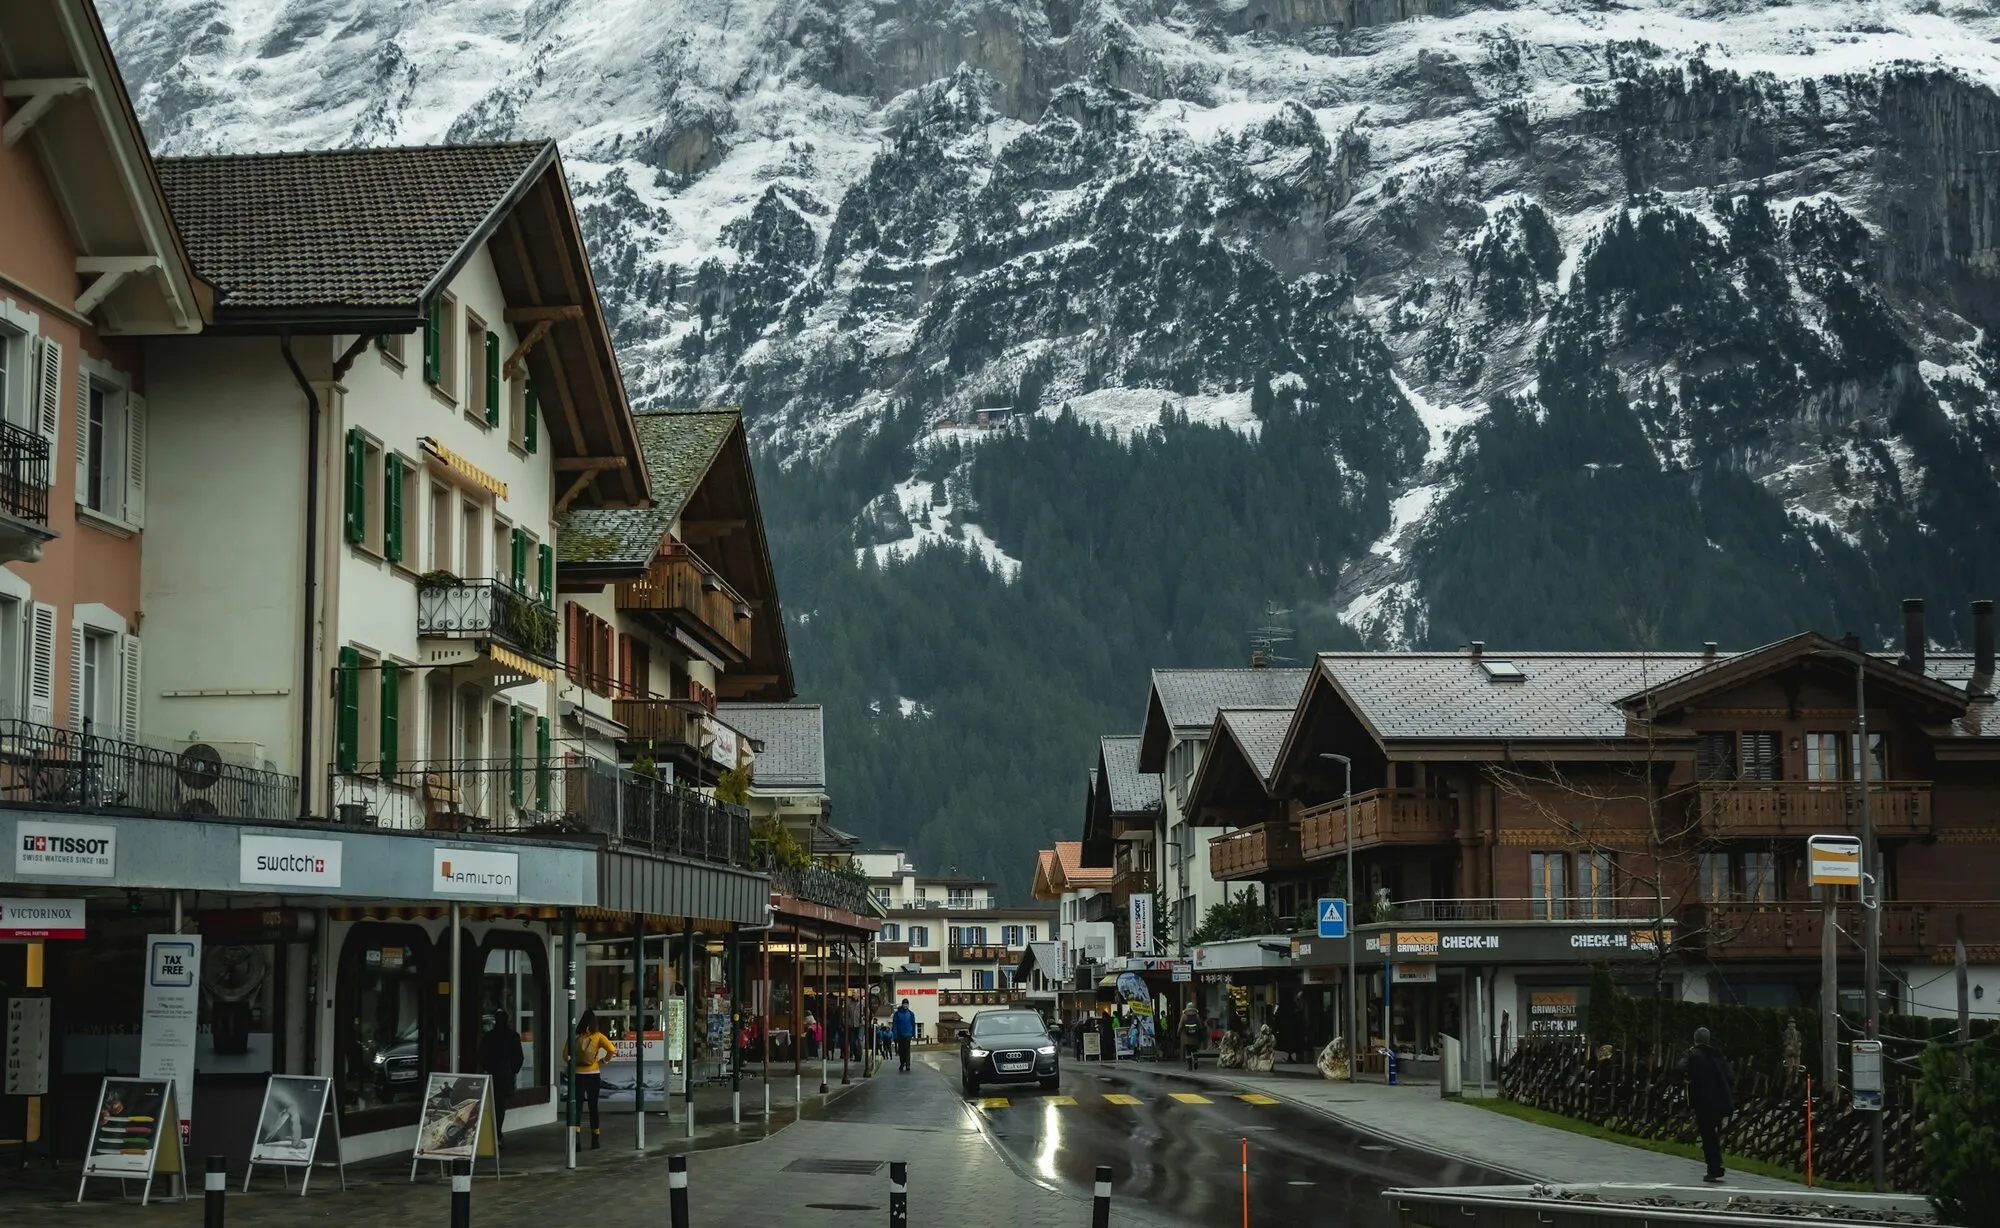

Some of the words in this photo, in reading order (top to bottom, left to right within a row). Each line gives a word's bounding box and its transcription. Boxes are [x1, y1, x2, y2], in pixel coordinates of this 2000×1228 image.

[48, 836, 108, 854] TISSOT
[22, 854, 43, 862] SWISS
[44, 855, 74, 863] WATCHES
[256, 854, 314, 873] swatch
[446, 872, 512, 886] HAMILTON
[10, 908, 72, 919] VICTORINOX
[1134, 899, 1142, 941] INTERSPORT
[1441, 936, 1499, 949] CHECK-IN
[1570, 935, 1628, 947] CHECK-IN
[1397, 944, 1438, 953] GRIWARENT
[164, 955, 182, 965] TAX
[162, 965, 184, 975] FREE
[1531, 1005, 1576, 1014] GRIWARENT
